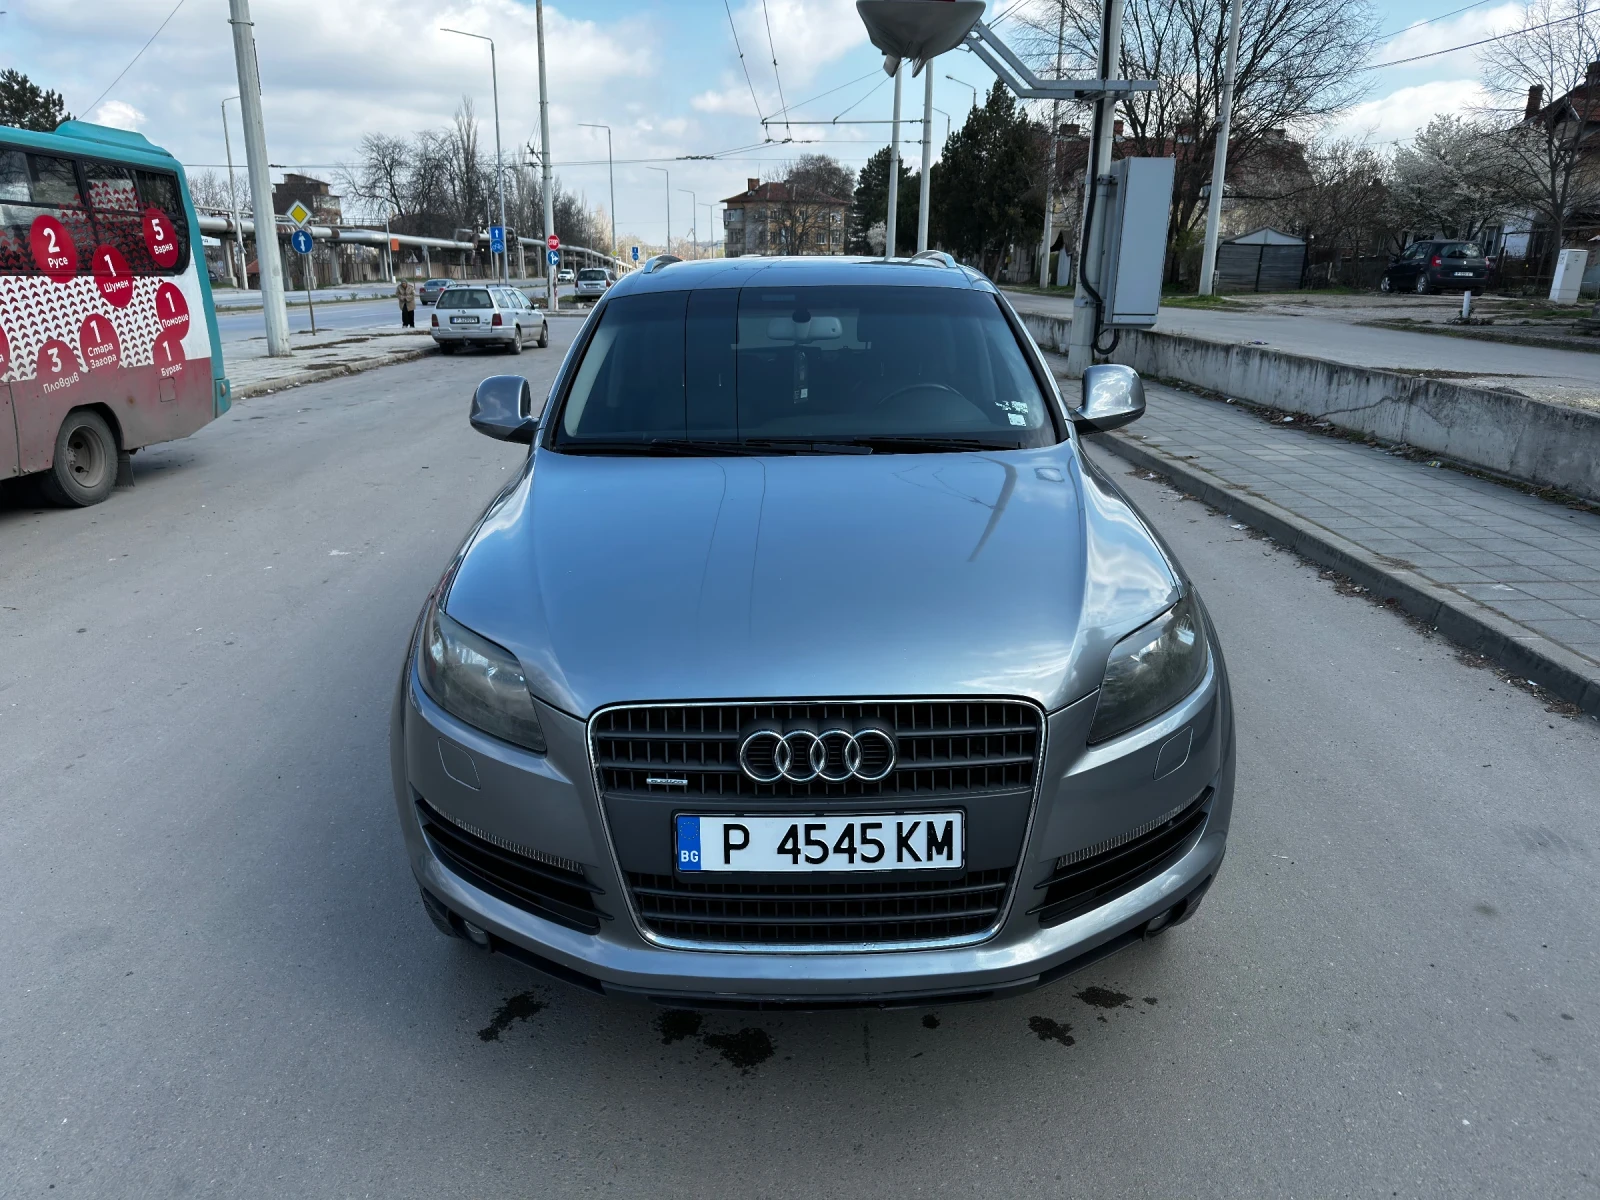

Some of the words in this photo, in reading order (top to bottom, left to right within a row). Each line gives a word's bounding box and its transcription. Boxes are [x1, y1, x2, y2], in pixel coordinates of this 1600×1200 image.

[151, 218, 165, 241] 5
[43, 227, 61, 254] 2
[153, 242, 174, 255] Варна
[47, 256, 69, 269] Русе
[104, 254, 117, 277] 1
[103, 279, 130, 294] Шумен
[165, 291, 176, 313] 1
[161, 313, 189, 328] Поморие
[90, 320, 101, 343] 1
[47, 347, 62, 373] 3
[87, 342, 114, 357] Стара
[162, 340, 172, 361] 1
[90, 354, 117, 369] Загора
[161, 362, 183, 377] Бургас
[43, 372, 80, 394] Пловдив
[723, 823, 750, 865] P
[681, 851, 699, 863] BG
